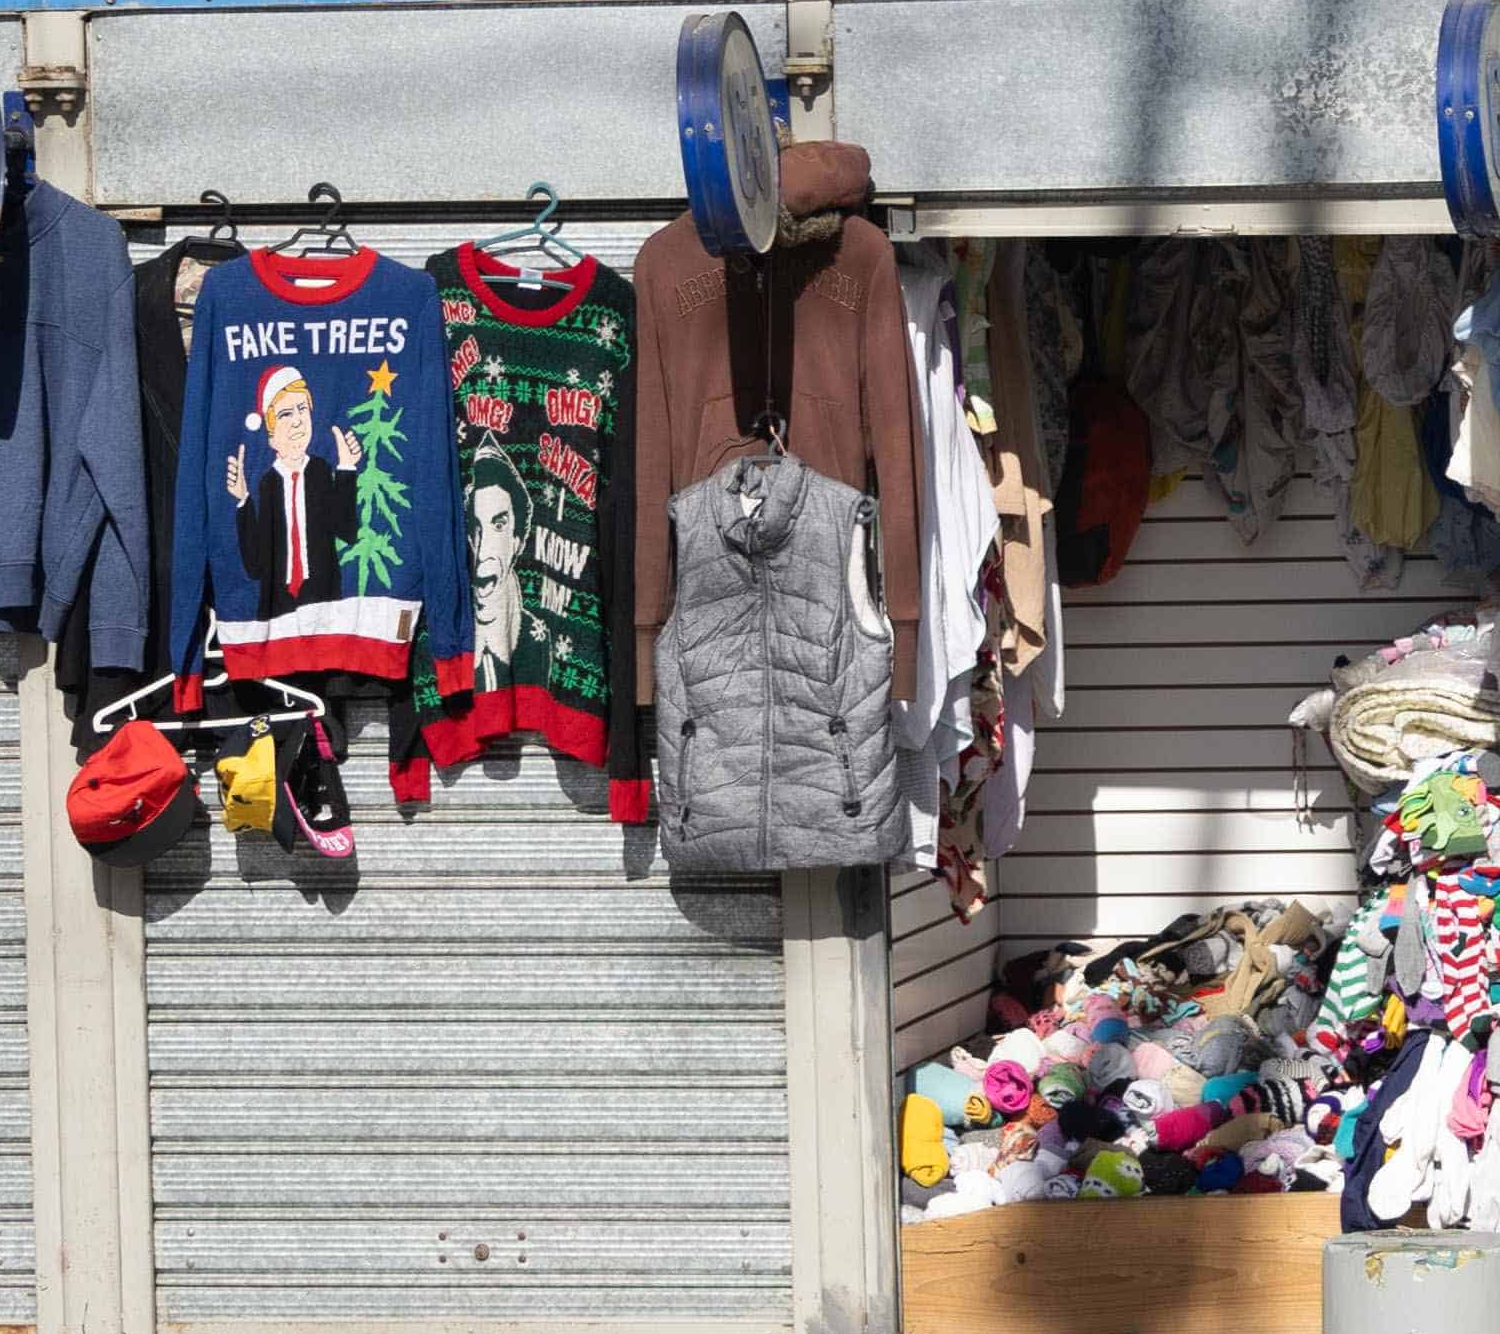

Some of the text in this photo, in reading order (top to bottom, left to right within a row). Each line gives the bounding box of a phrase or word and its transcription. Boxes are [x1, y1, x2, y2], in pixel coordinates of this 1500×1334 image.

[225, 318, 409, 362] FAKE TREES
[467, 393, 513, 434] OMG!
[546, 386, 602, 431] OMG!
[538, 432, 597, 510] SANTA
[535, 525, 591, 579] KNOW
